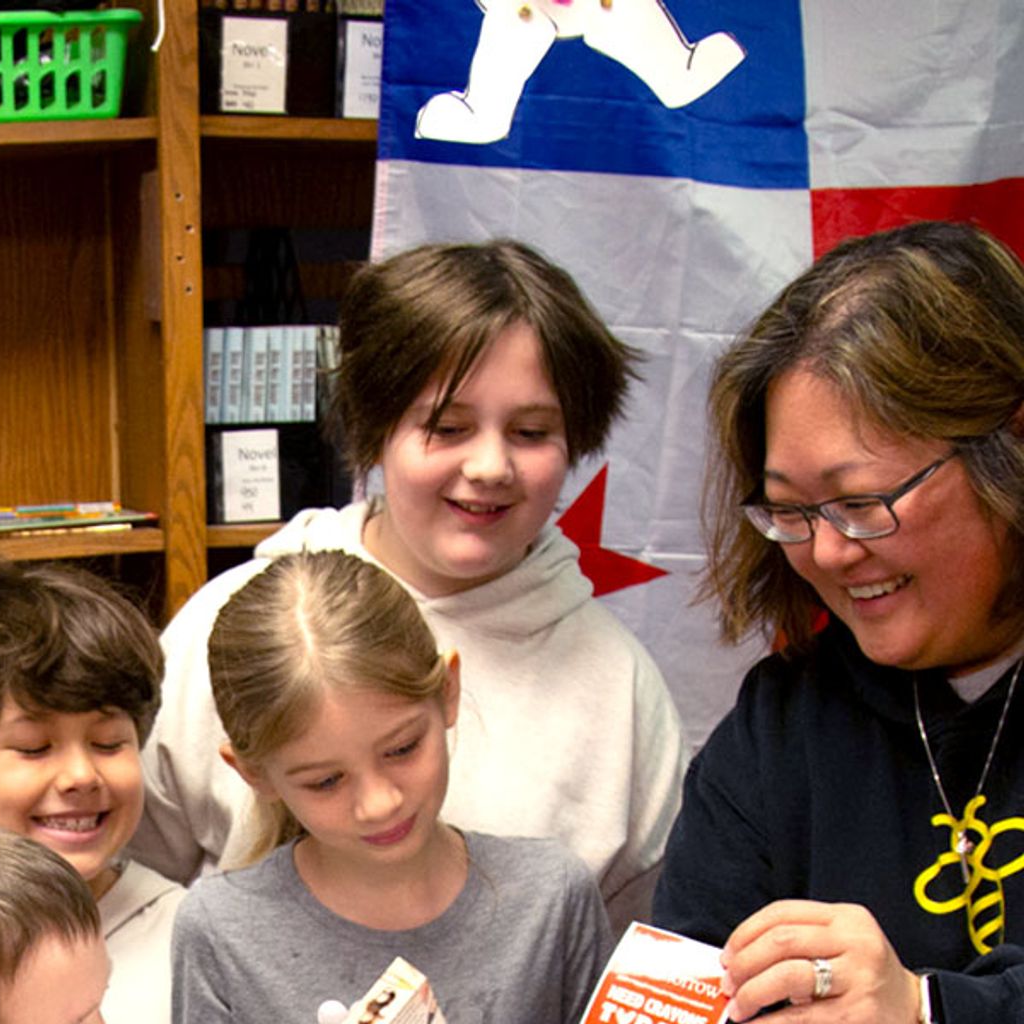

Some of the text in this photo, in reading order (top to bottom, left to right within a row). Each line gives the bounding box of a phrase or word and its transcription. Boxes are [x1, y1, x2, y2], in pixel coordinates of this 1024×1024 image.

[232, 43, 273, 57] Nove
[238, 447, 277, 461] Novel
[605, 984, 645, 1010] NEED
